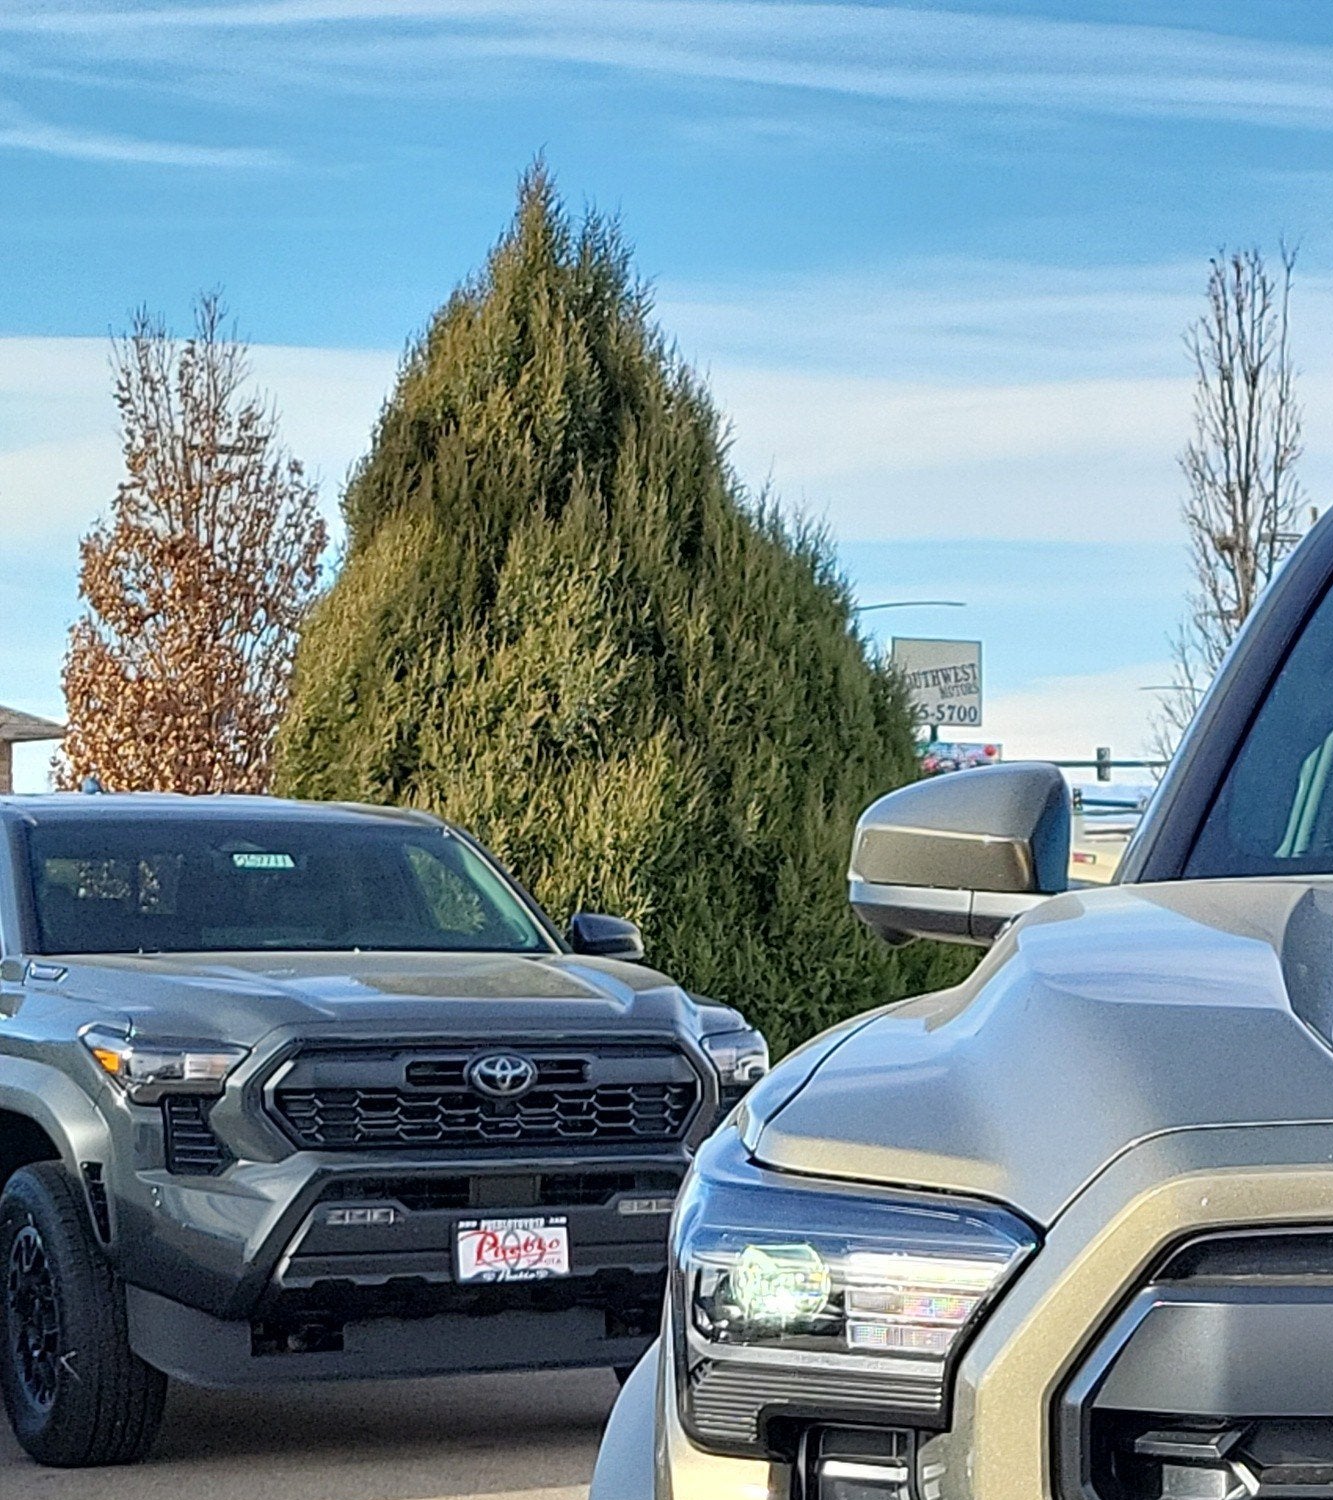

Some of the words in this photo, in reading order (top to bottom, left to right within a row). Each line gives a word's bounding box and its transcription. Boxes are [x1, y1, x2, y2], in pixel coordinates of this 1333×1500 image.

[902, 663, 978, 690] OUTHWEST
[918, 703, 978, 722] 5-5700
[458, 1230, 560, 1266] Pueblo
